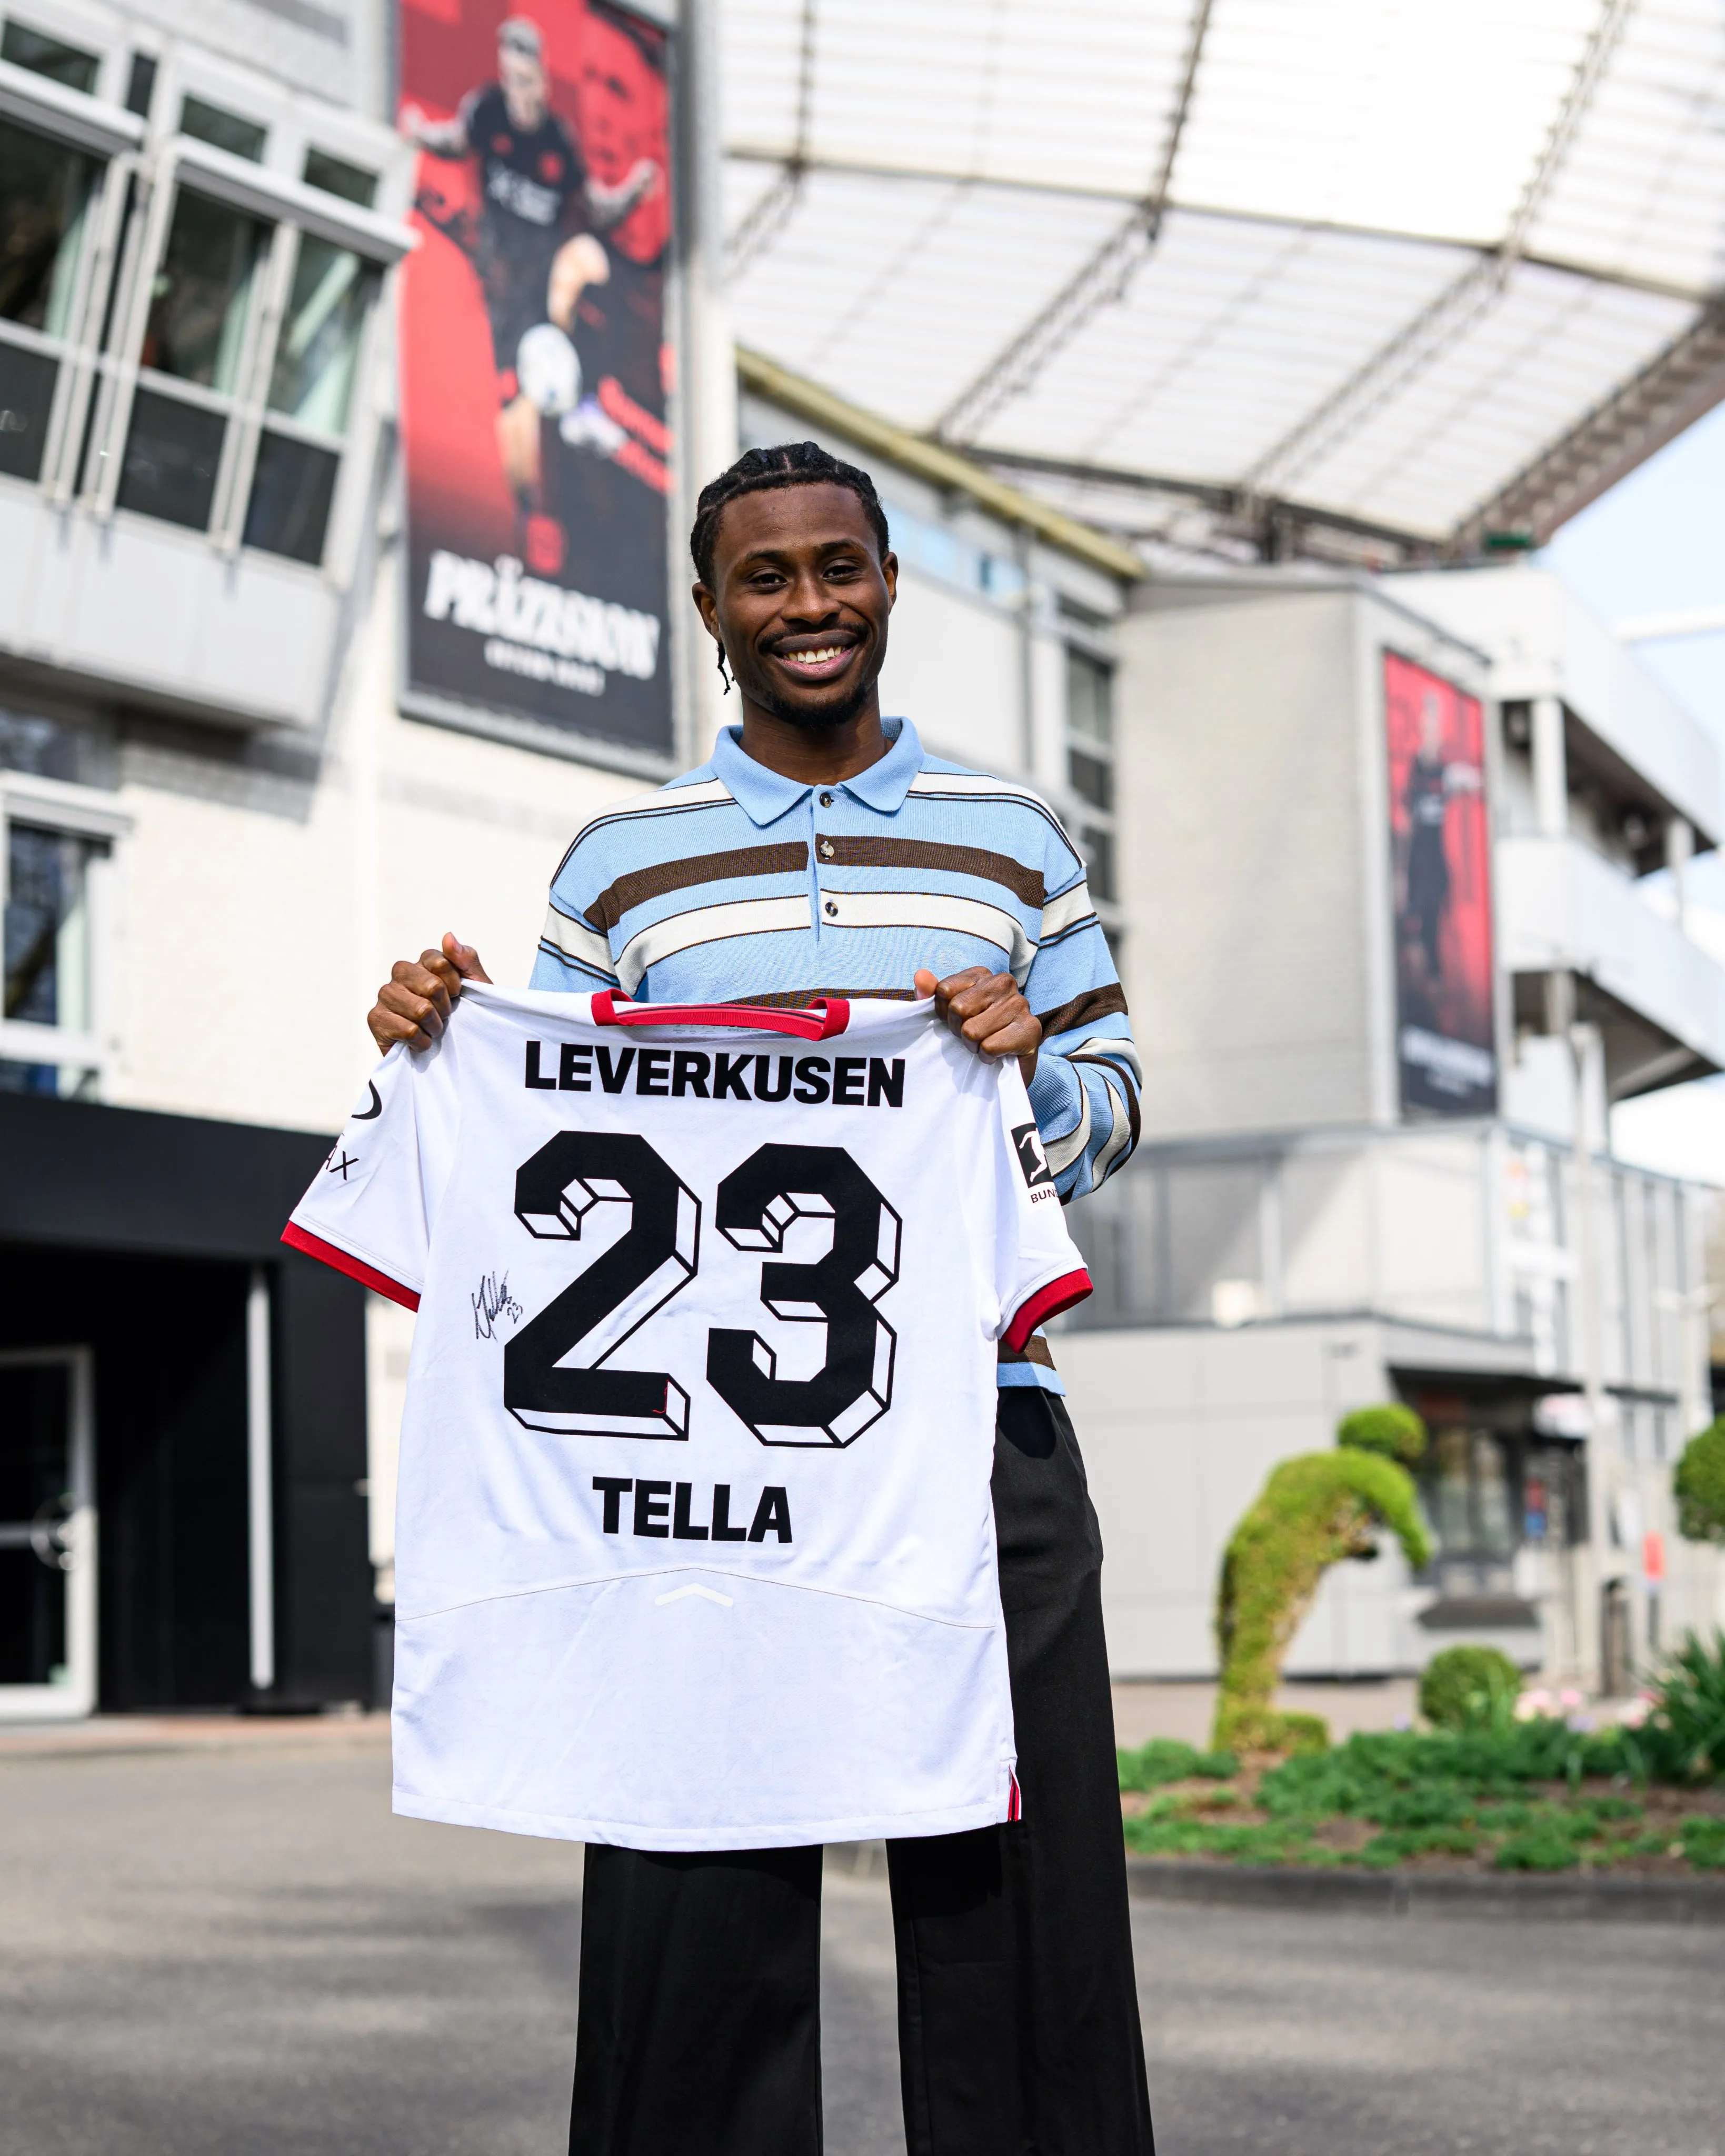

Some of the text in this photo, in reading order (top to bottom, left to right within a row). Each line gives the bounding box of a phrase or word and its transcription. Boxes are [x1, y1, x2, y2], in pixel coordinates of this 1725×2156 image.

[525, 1041, 905, 1107] LEVERKUSEN
[503, 1130, 903, 1449] 23
[592, 1476, 793, 1543] TELLA
